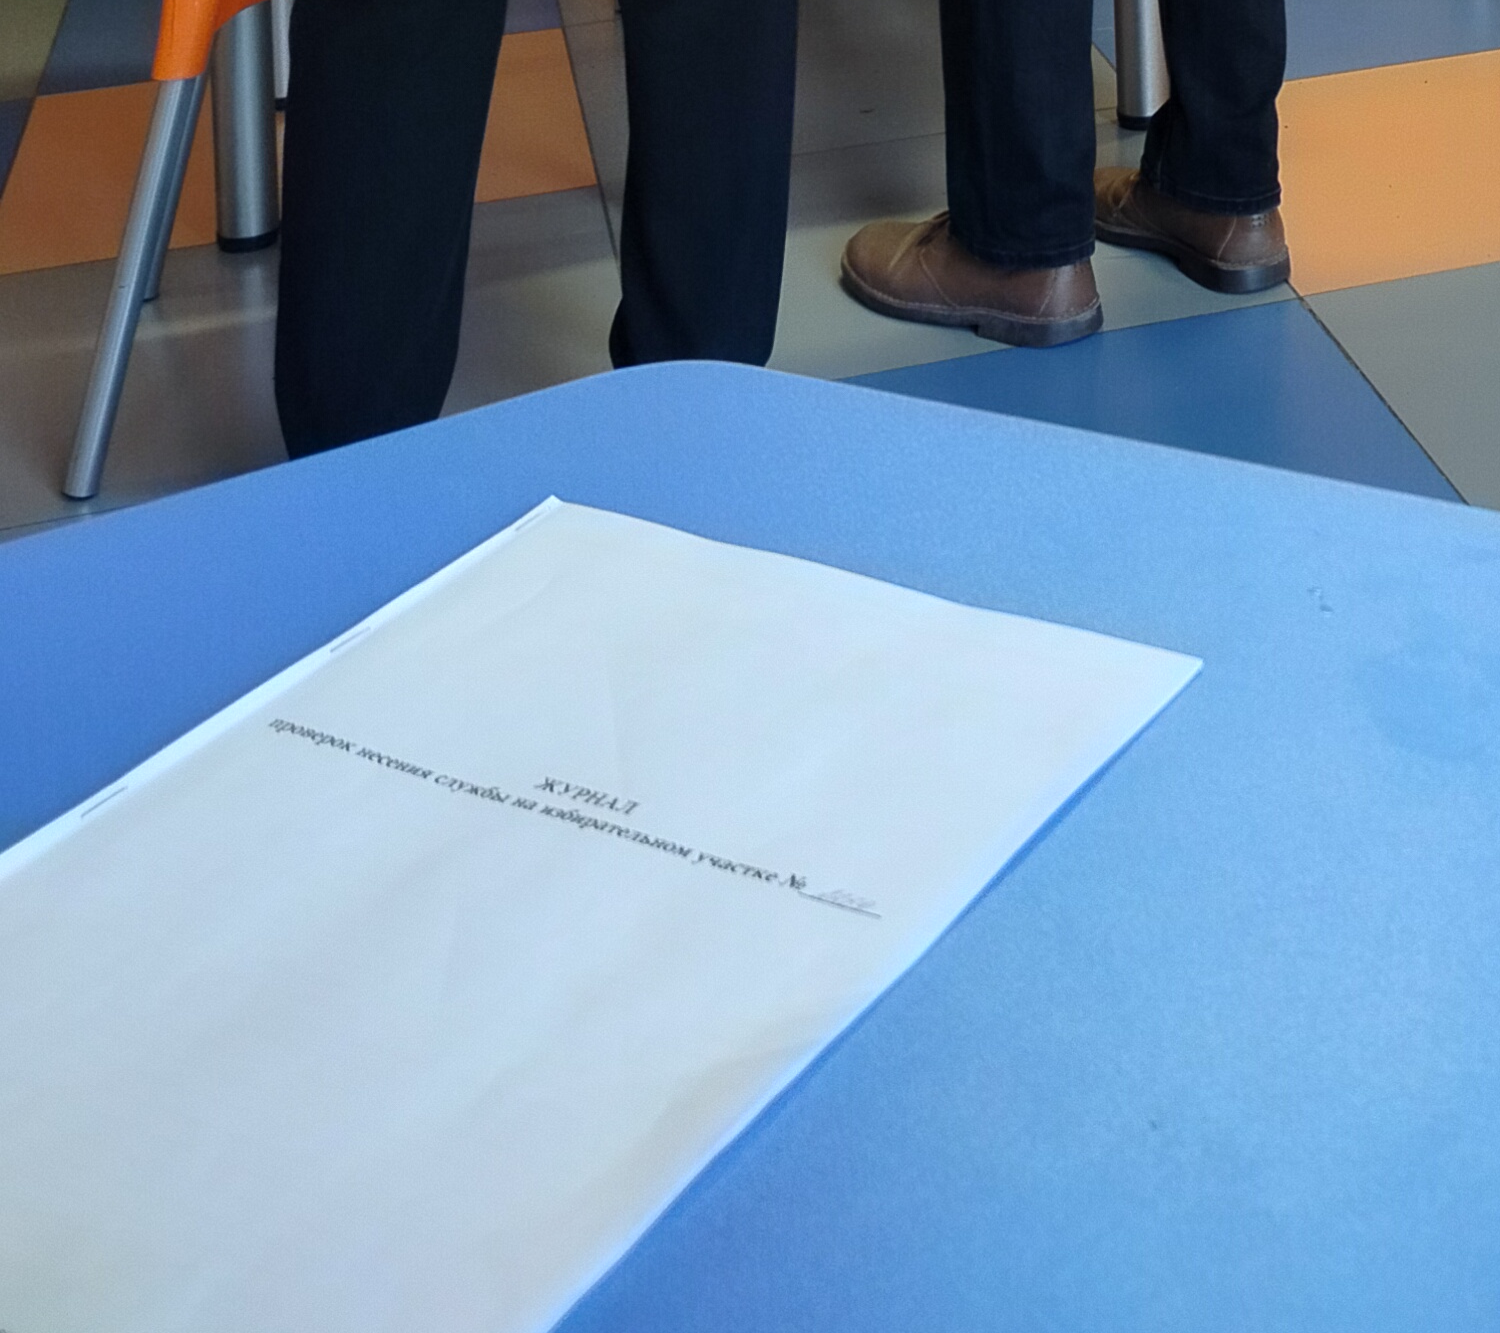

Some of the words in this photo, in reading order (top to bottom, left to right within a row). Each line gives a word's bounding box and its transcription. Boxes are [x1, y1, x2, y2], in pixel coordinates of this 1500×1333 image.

[268, 717, 356, 752] проверок
[356, 746, 435, 780] несения
[434, 773, 510, 804] службы
[511, 796, 538, 812] на
[540, 804, 692, 858] избирательном
[692, 850, 778, 883] участке
[535, 776, 640, 815] ЖУРНАЛ
